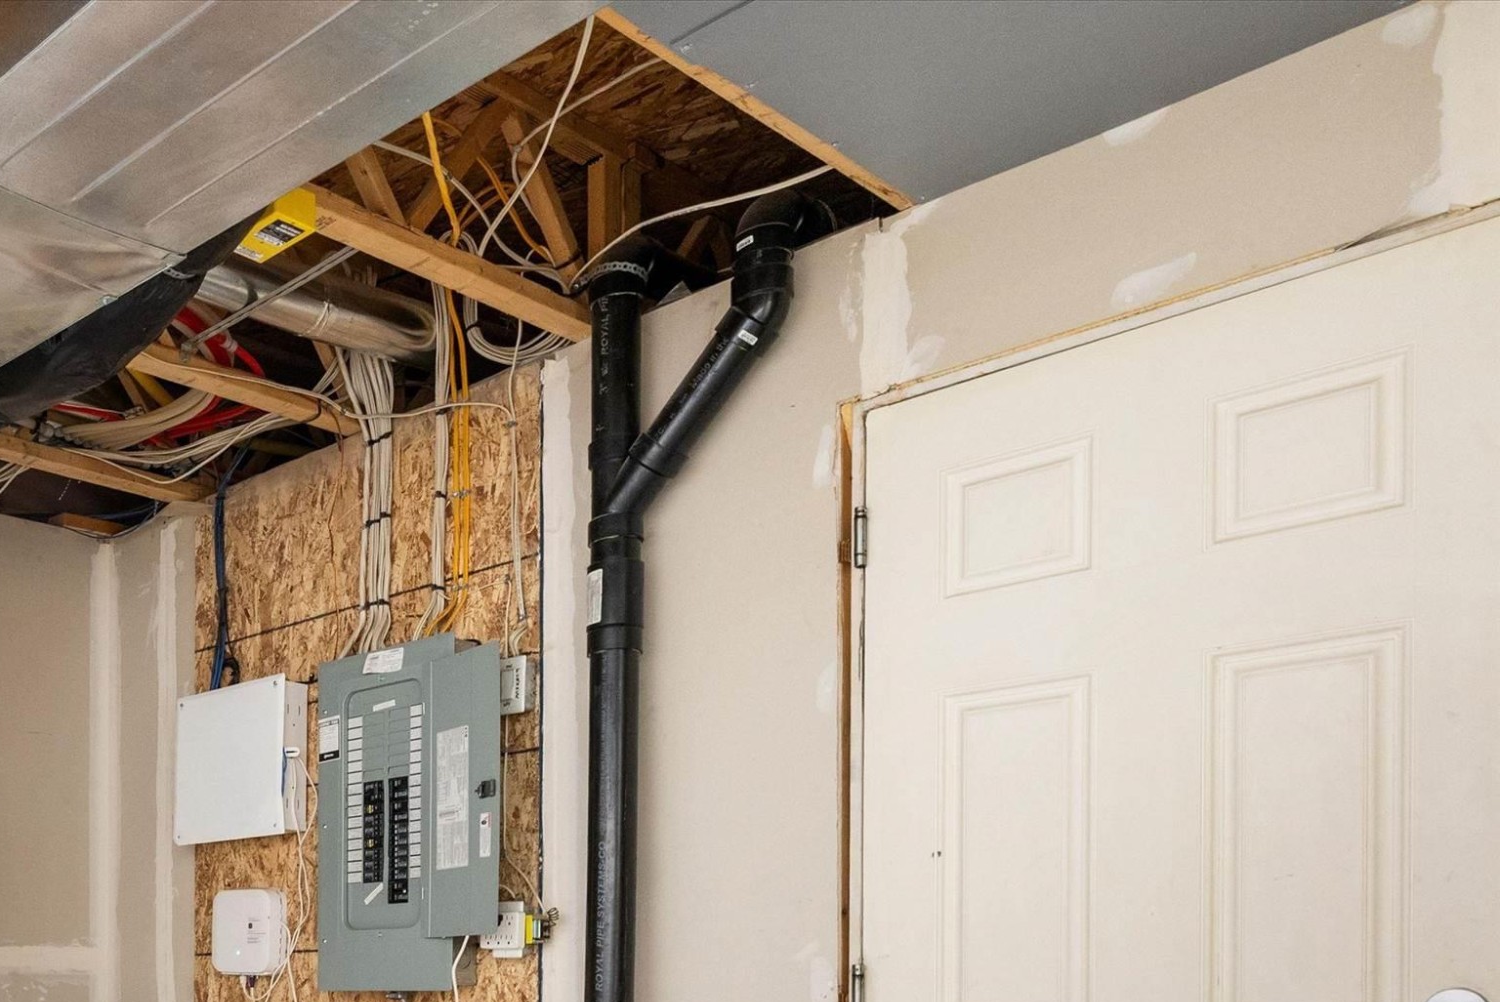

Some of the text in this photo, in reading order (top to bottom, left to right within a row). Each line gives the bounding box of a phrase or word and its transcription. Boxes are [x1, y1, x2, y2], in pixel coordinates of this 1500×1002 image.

[600, 315, 609, 355] ROYAL
[596, 921, 605, 946] PIPE
[595, 951, 604, 992] ROYAL
